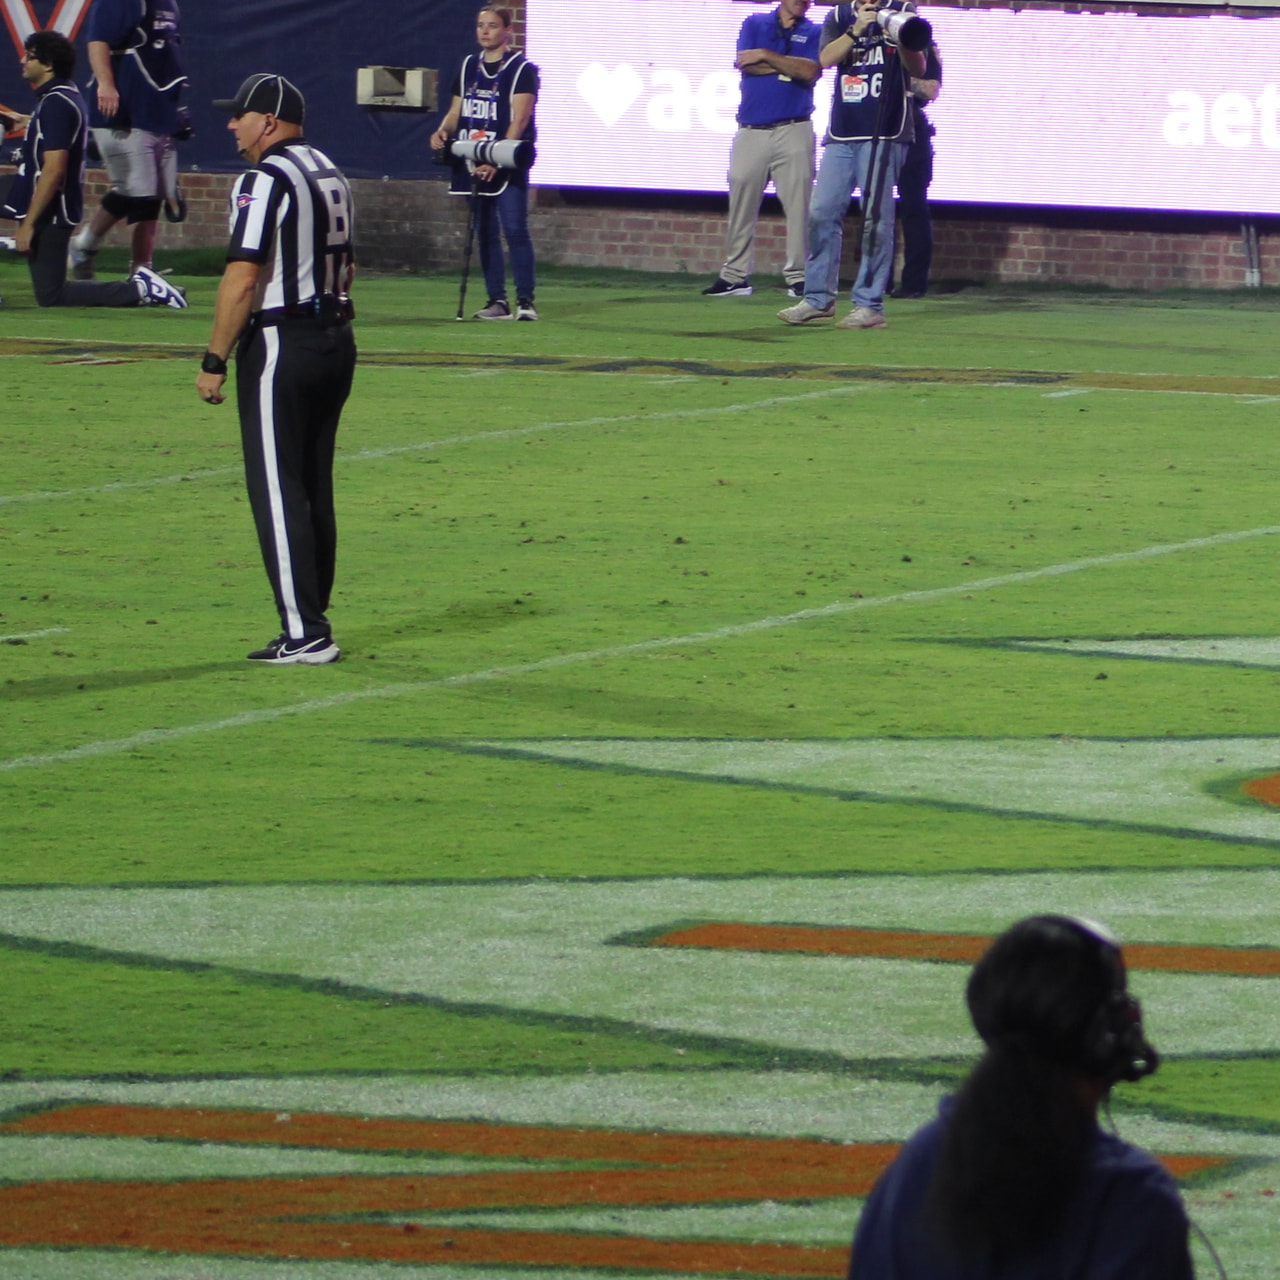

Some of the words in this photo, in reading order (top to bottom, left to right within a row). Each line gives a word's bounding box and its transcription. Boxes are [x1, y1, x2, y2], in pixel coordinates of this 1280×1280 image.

[840, 72, 883, 98] 56
[461, 99, 497, 121] MEDIA
[325, 176, 348, 246] B
